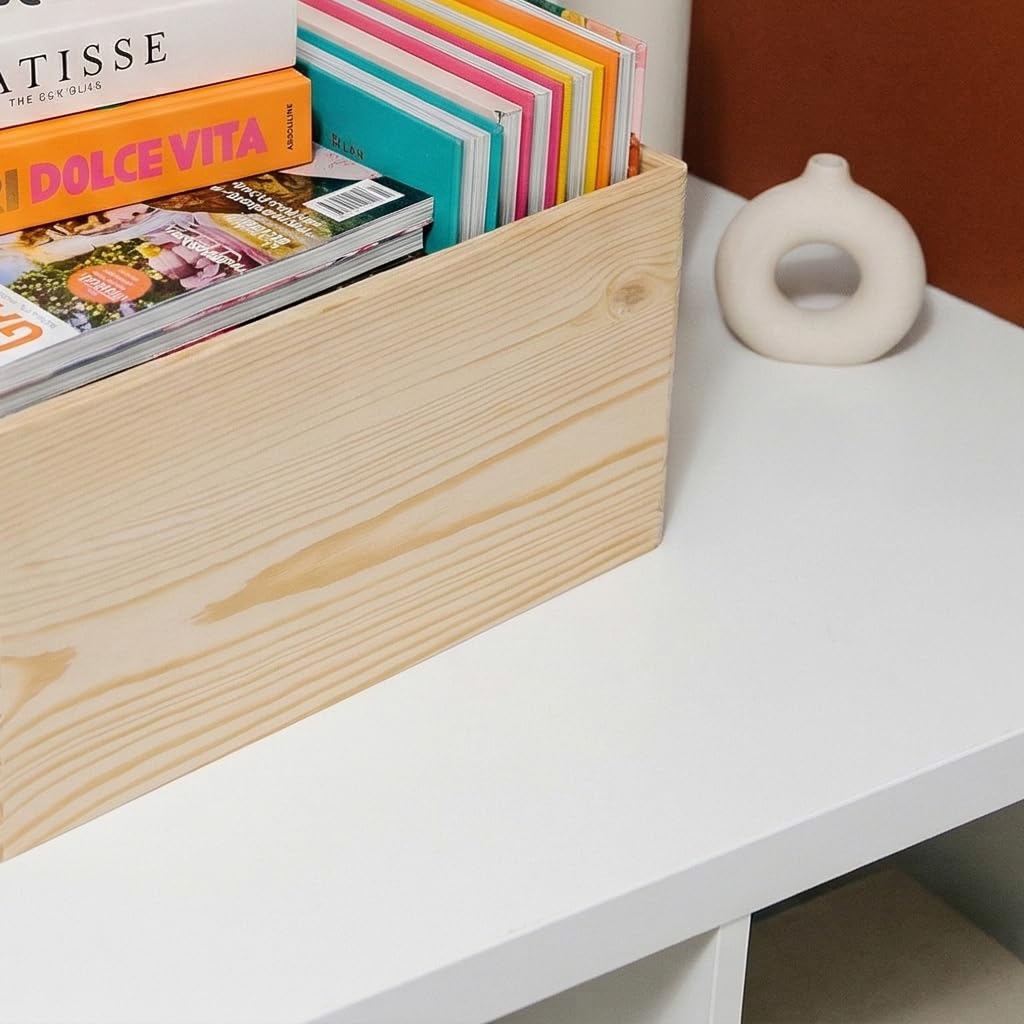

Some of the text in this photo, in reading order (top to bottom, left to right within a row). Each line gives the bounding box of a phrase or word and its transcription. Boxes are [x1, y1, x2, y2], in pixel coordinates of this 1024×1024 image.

[9, 94, 33, 107] THE
[30, 138, 163, 205] DOLCE
[168, 117, 268, 171] VITA
